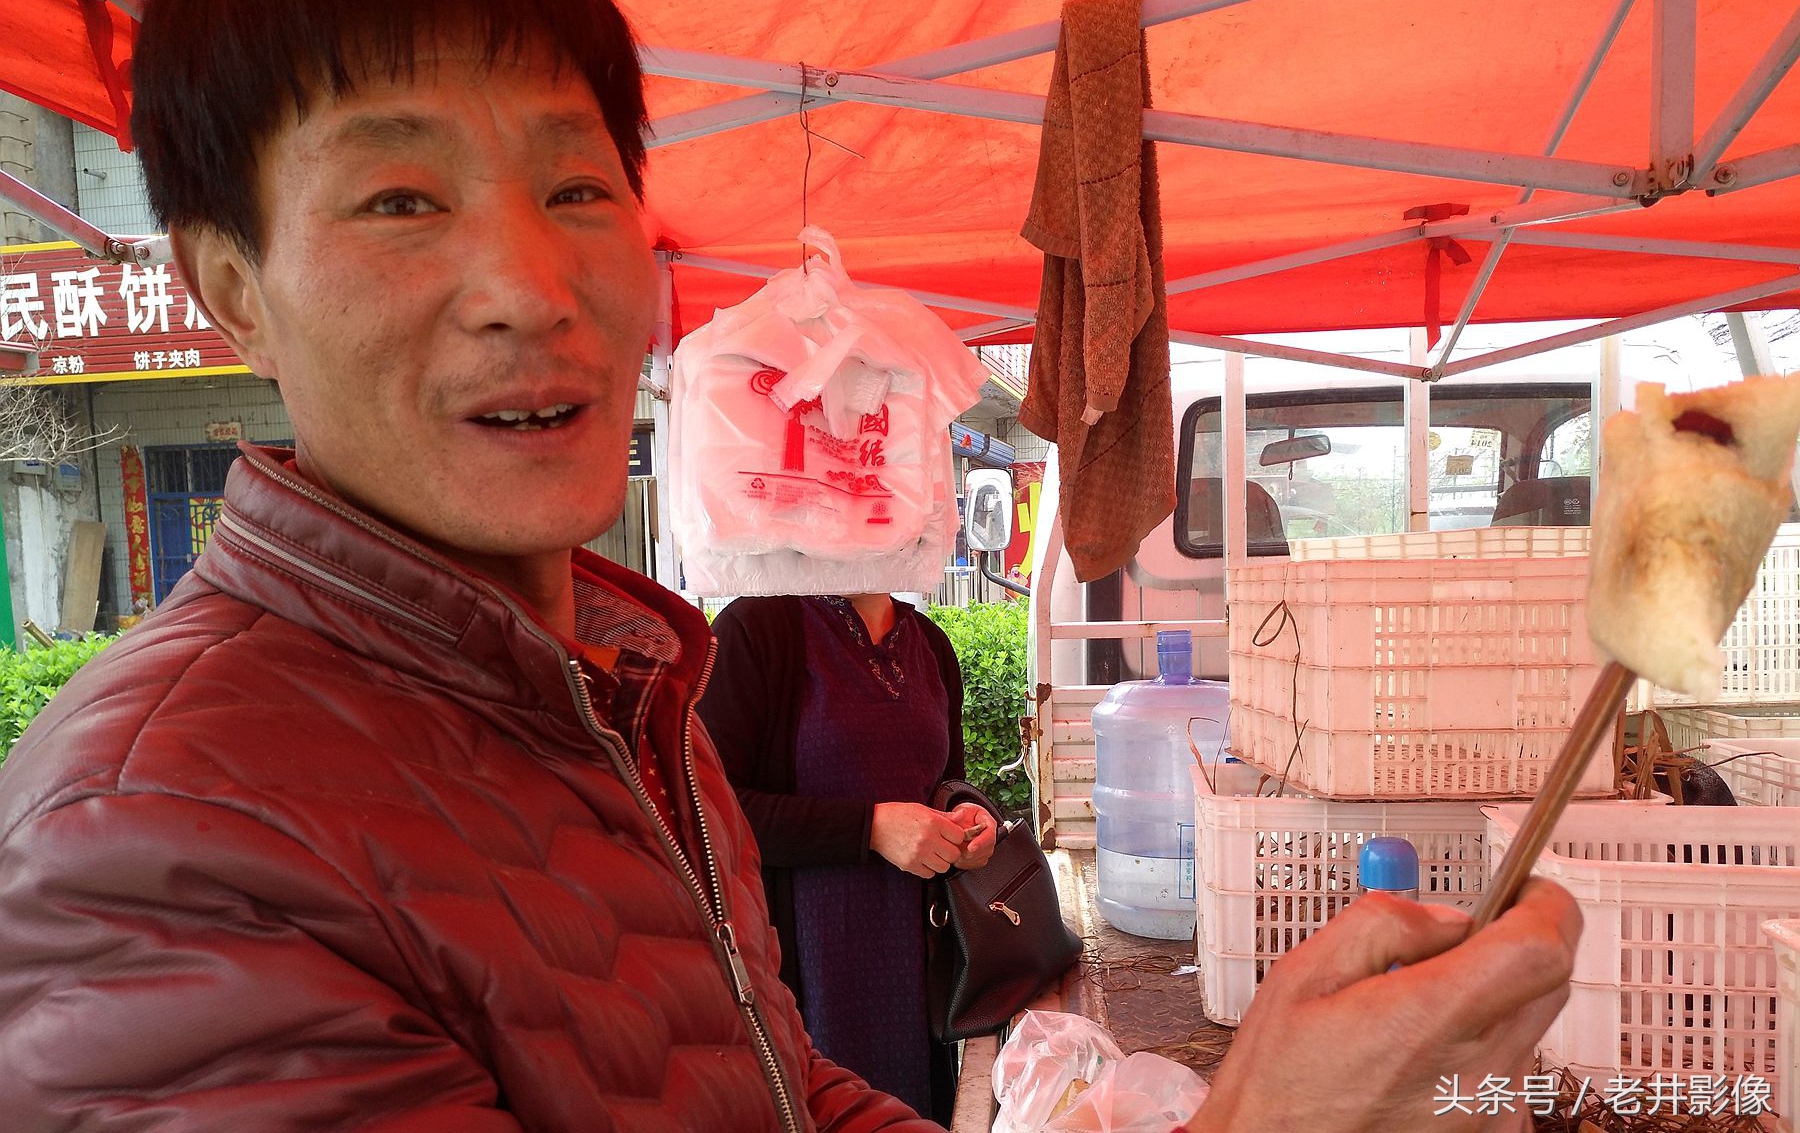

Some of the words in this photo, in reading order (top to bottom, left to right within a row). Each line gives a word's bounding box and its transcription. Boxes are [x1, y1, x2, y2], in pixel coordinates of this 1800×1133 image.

[52, 355, 85, 374] 凉粉
[133, 348, 201, 370] 饼子夹肉
